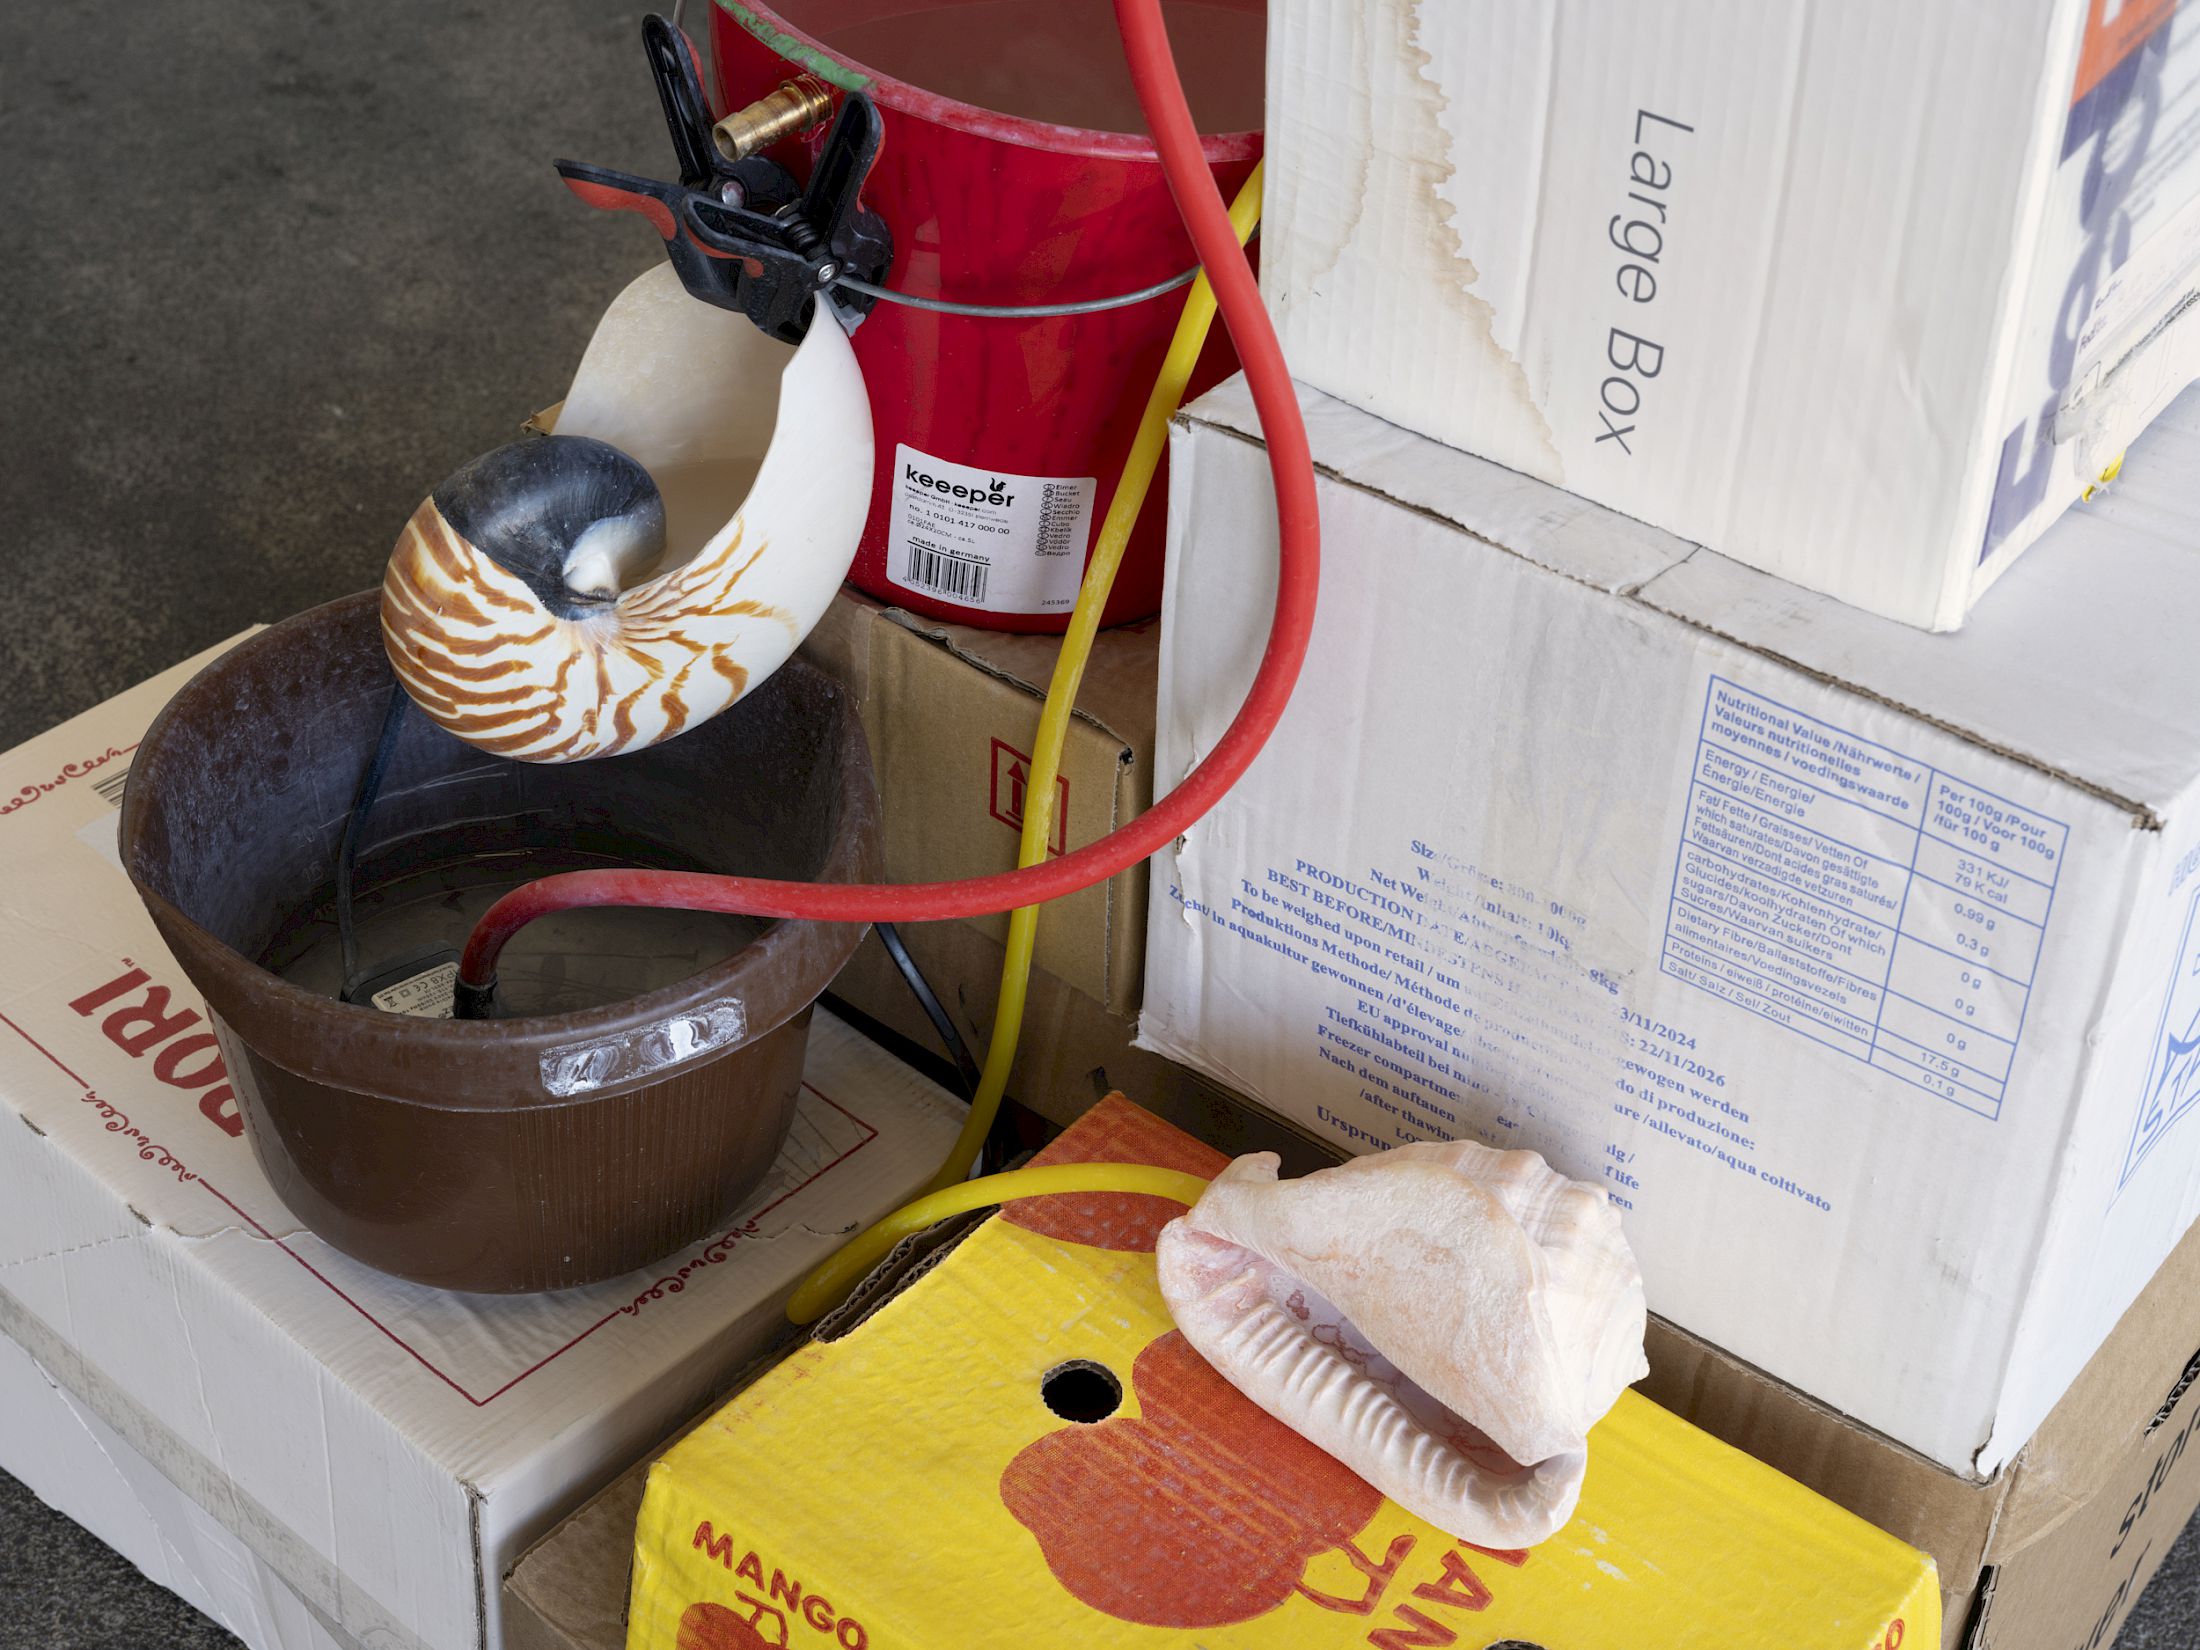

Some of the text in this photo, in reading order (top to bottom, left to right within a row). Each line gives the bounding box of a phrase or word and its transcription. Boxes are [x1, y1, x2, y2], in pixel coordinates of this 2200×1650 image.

[1594, 108, 1695, 456] Large Box
[906, 464, 1015, 508] keeeper
[909, 503, 923, 513] no.
[934, 511, 955, 524] 0101
[958, 518, 975, 529] 417
[978, 523, 996, 533] 000
[998, 527, 1011, 535] 00
[912, 534, 991, 563] made in germany
[1711, 721, 1909, 809] moyennes voedingswaarde
[1715, 704, 1860, 776] Valeurs nutritionelles
[1716, 689, 1912, 780] Nutritional Value /Nährwerte
[1702, 763, 1805, 817] Énergie/Energie
[1705, 748, 1815, 804] Energy Energie/
[1939, 784, 2046, 838] Per 100g /Pour
[1694, 816, 1897, 910] Fettsäuren/Dont acides gras saturés/
[1696, 805, 1878, 888] which saturates/Davon gesättigte
[1722, 800, 1750, 820] Fette
[1759, 816, 1812, 845] Graisses/
[1815, 839, 1850, 862] Vetten
[1853, 855, 1868, 869] Of
[1933, 813, 2000, 852] /für 100 g
[1938, 800, 2054, 860] 100g Voor 100g
[1295, 858, 1414, 920] PRODUCTION
[1687, 852, 1881, 939] carbohydrates/Kohlenhydrate/
[1692, 829, 1852, 906] Waarvan verzadigde vetzuren
[1955, 872, 1971, 887] 79
[1987, 889, 2007, 903] cal
[1957, 859, 1981, 875] 331
[1369, 867, 1621, 995] Net 8kg
[1680, 887, 1832, 960] Sucres/Waarvan suikers
[1683, 877, 1851, 955] sugars/Davon Zucker/Dont
[1685, 862, 1885, 956] Glucides/koolhydraten Of which
[1953, 903, 1995, 931] 0.99 g
[1267, 867, 1310, 896] BEST
[1639, 1039, 1725, 1086] 22/11/2026
[1675, 923, 1846, 1004] alimentaires/Voedingsvezels
[1677, 906, 1876, 1000] Dietary Fibre/Ballaststoffe/Fibres
[1956, 933, 1989, 957] 0.3 g
[1960, 971, 1981, 989] 0 g
[1231, 897, 1318, 947] Produktions
[1321, 938, 1392, 980] Methode/
[1393, 972, 1460, 1012] Méthode
[1638, 1088, 1654, 1103] di
[1656, 1098, 1753, 1149] produzione:
[1240, 878, 1258, 897] To
[1261, 887, 1278, 905] be
[1281, 899, 1340, 934] weighed
[1344, 928, 1380, 953] upon
[1384, 948, 1424, 973] retail
[1436, 971, 1459, 989] um
[1689, 1087, 1748, 1123] werden
[1668, 961, 1790, 1023] Salt/ Salz Sel/ Zout
[1671, 941, 1868, 1035] Proteins eiweiß protéine/eiwitten
[1954, 998, 1975, 1016] 0 g
[1325, 1005, 1424, 1063] Tiefkühlabteil
[1428, 1054, 1449, 1075] bei
[1357, 999, 1379, 1017] EU
[1383, 1014, 1448, 1051] approval
[1946, 1032, 1966, 1050] 0 g
[1212, 910, 1225, 926] in
[1228, 921, 1309, 964] aquakultur
[1310, 960, 1383, 1000] gewonnen
[1643, 1113, 1757, 1177] /allevato/aqua
[1760, 1168, 1832, 1213] coltivato
[1319, 1046, 1455, 1122] Nach dem auftauen
[1921, 1052, 1959, 1078] 17.5 g
[1923, 1074, 1955, 1097] 0.1 g
[1317, 1023, 1371, 1057] Freezer
[1614, 1168, 1639, 1189] life
[1359, 1088, 1399, 1114] /after
[692, 1520, 869, 1650] MANGO
